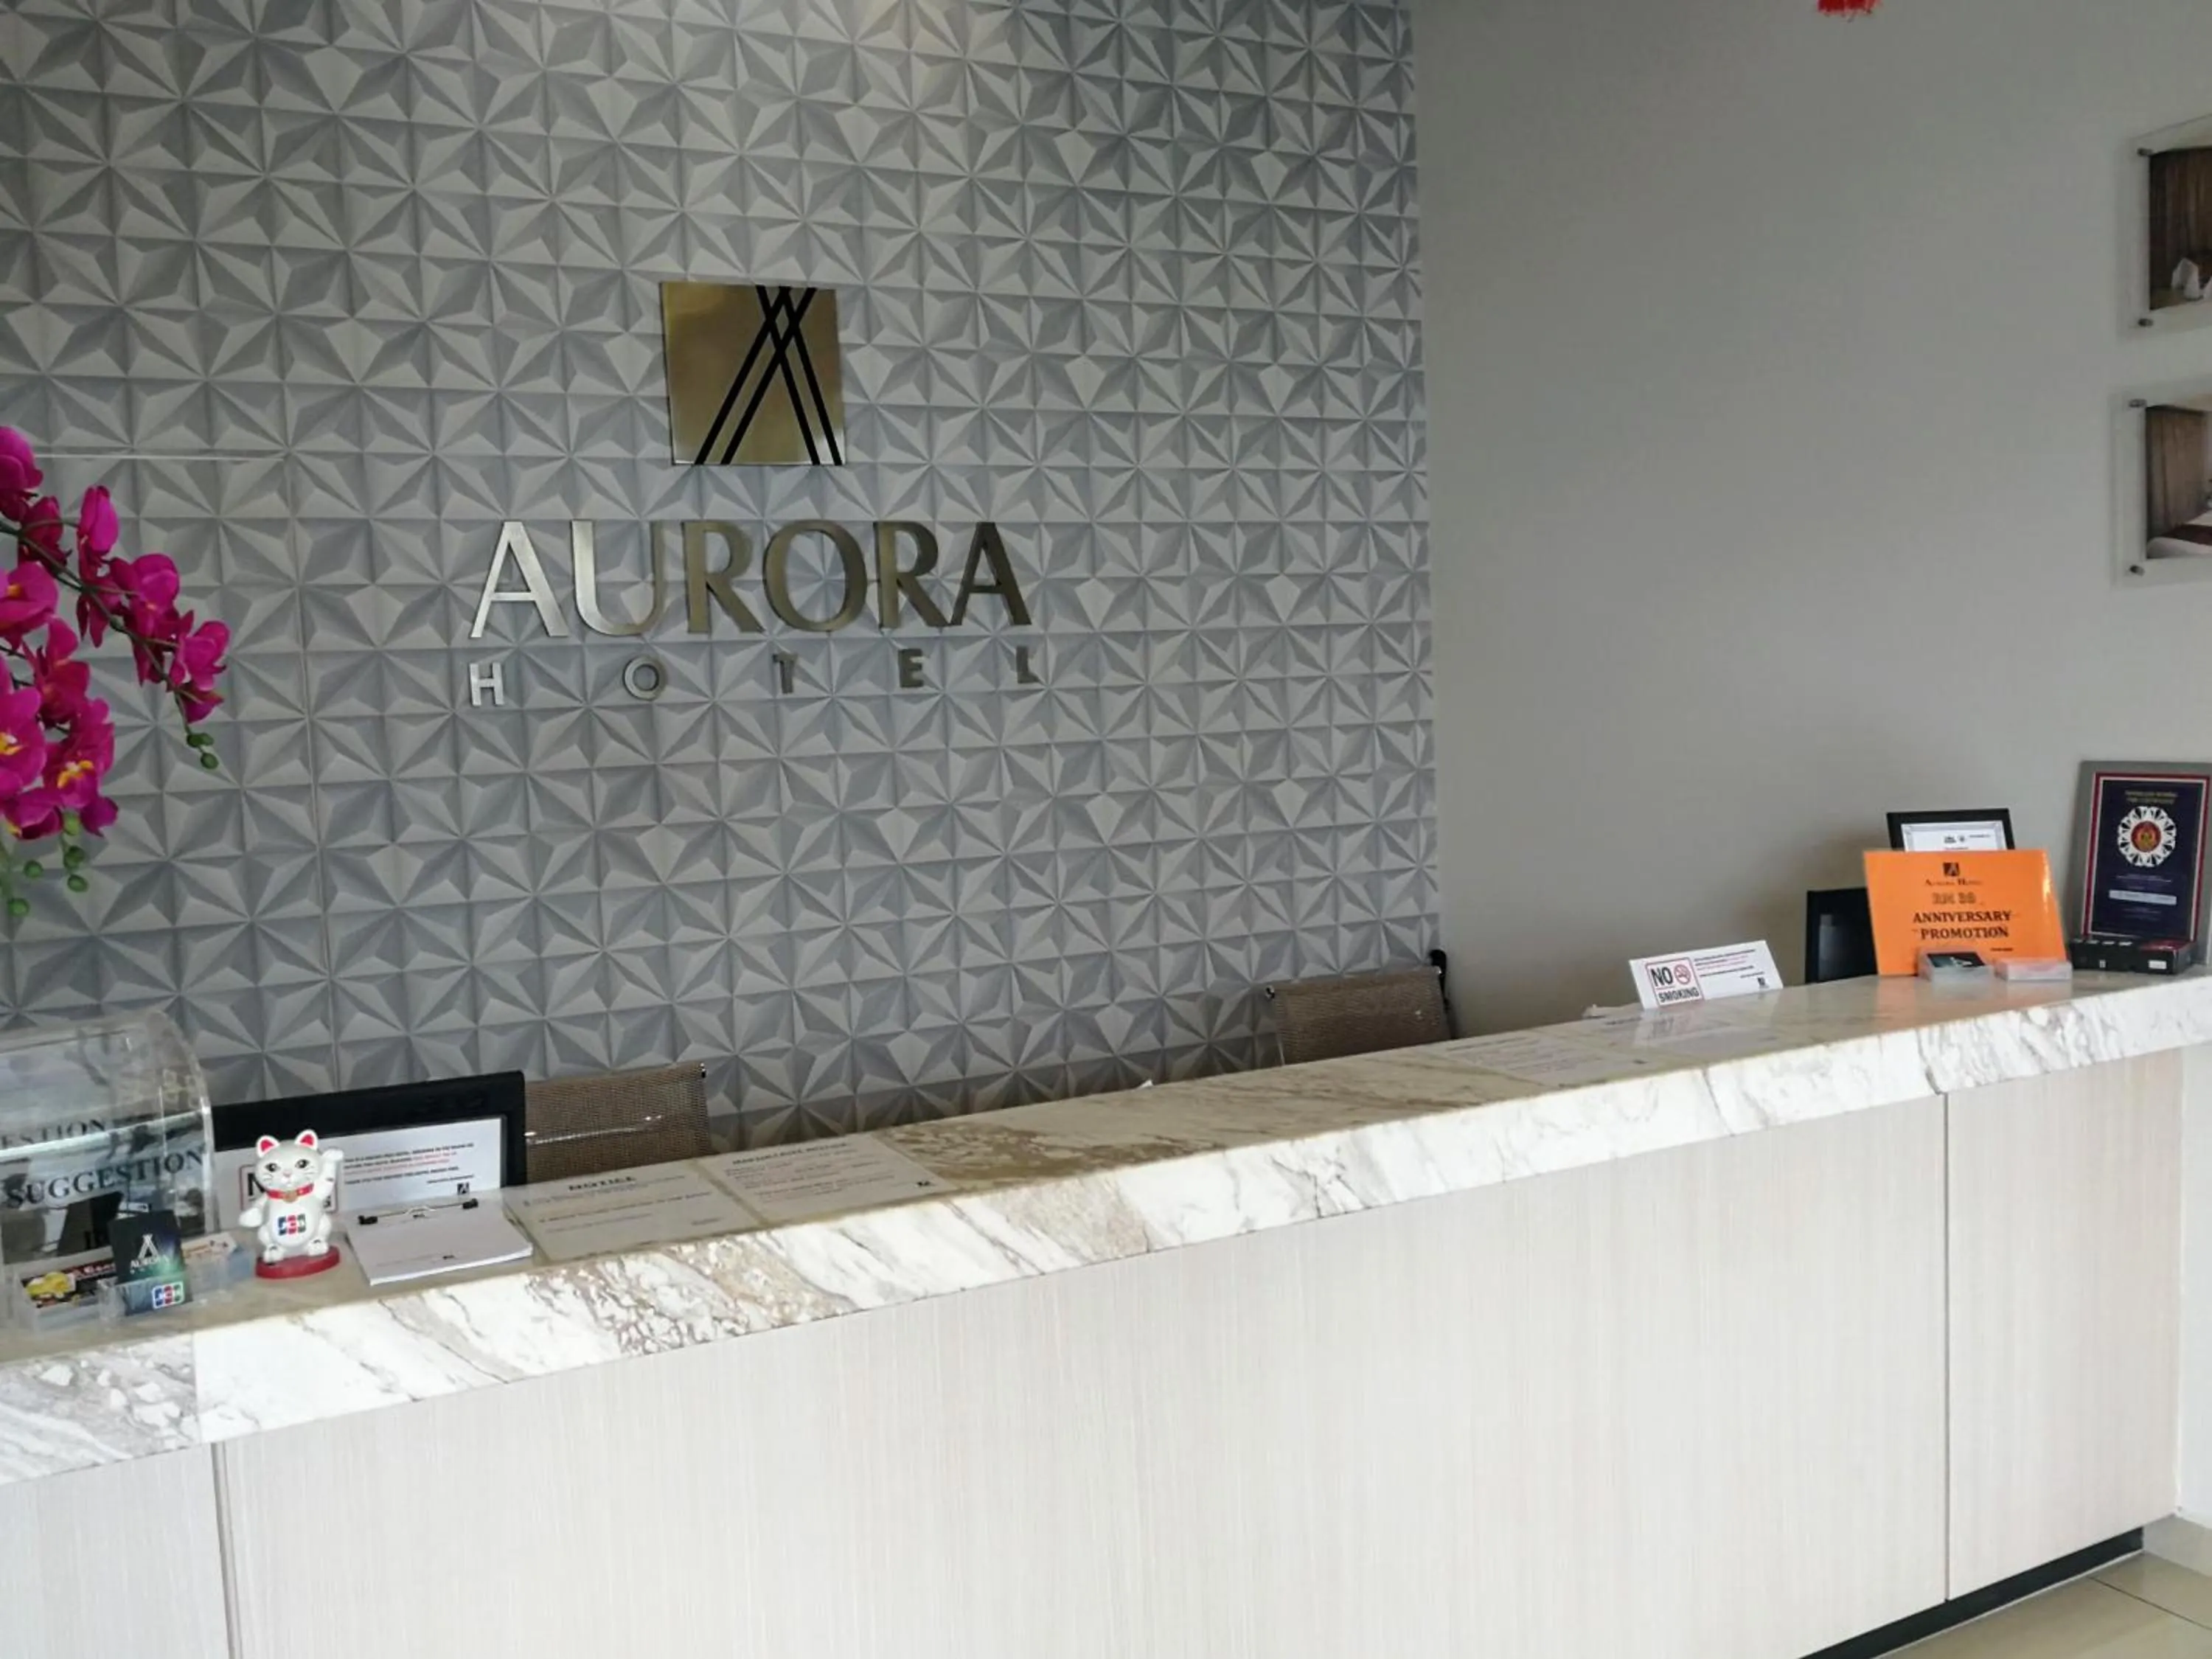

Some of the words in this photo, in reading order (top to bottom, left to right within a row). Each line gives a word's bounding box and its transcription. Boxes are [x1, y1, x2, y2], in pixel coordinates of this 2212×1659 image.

[469, 519, 1032, 639] AURORA
[468, 645, 1040, 707] HOTEL
[1913, 911, 2012, 924] ANNIVERSARY
[1920, 926, 2009, 940] PROMOTION
[1651, 967, 1674, 987] NO
[1658, 987, 1699, 1003] SMOKING
[6, 1144, 206, 1210] SUGGESTION
